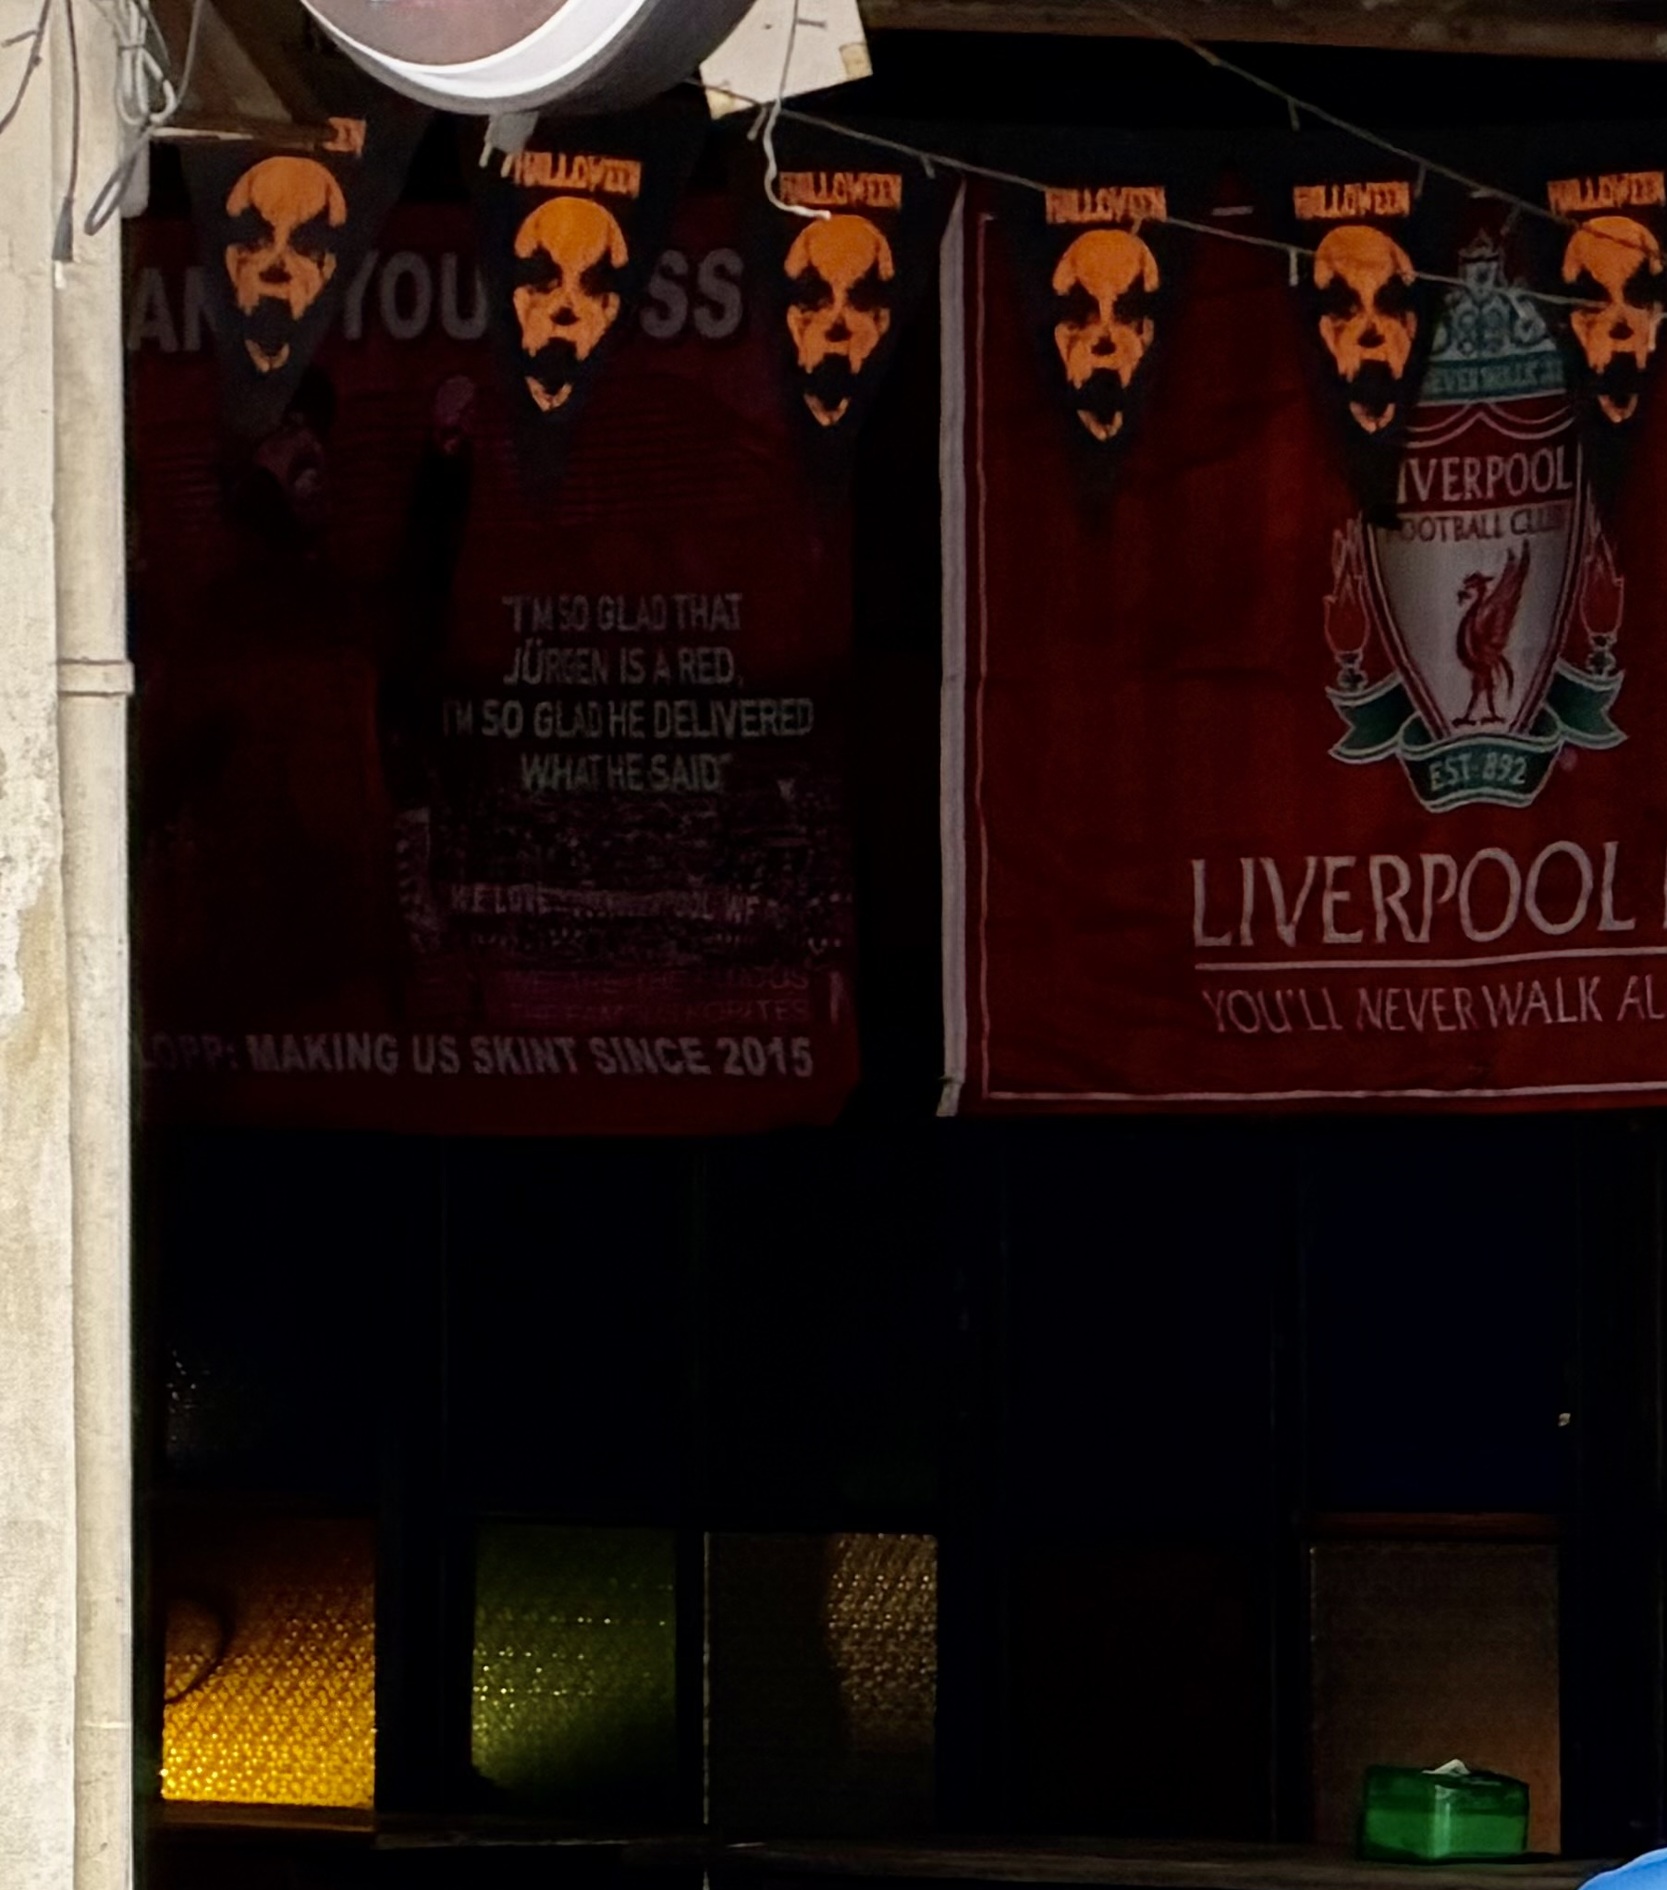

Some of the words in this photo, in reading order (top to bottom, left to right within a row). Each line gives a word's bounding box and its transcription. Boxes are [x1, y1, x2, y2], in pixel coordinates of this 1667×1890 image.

[1396, 444, 1574, 504] IVERPOOL
[1400, 511, 1503, 542] OOTBALL
[598, 594, 669, 632] GLAD
[672, 592, 742, 631] THAT
[619, 647, 647, 685] IS
[653, 649, 673, 684] A
[480, 698, 526, 739] SO
[532, 698, 602, 740] GLAD
[606, 699, 647, 739] HE
[652, 696, 816, 740] DELIVERED
[519, 751, 602, 792] WHAT
[605, 751, 645, 790] HE
[1192, 839, 1636, 947] LIVERPOOL
[1203, 983, 1343, 1034] YOU'LL
[1357, 987, 1475, 1032] NEVER
[1481, 976, 1602, 1028] WALK
[245, 1030, 399, 1077] MAKING
[411, 1033, 461, 1075] US
[469, 1035, 577, 1077] SKINT
[588, 1035, 713, 1077] SINCE
[716, 1036, 814, 1078] 2015
